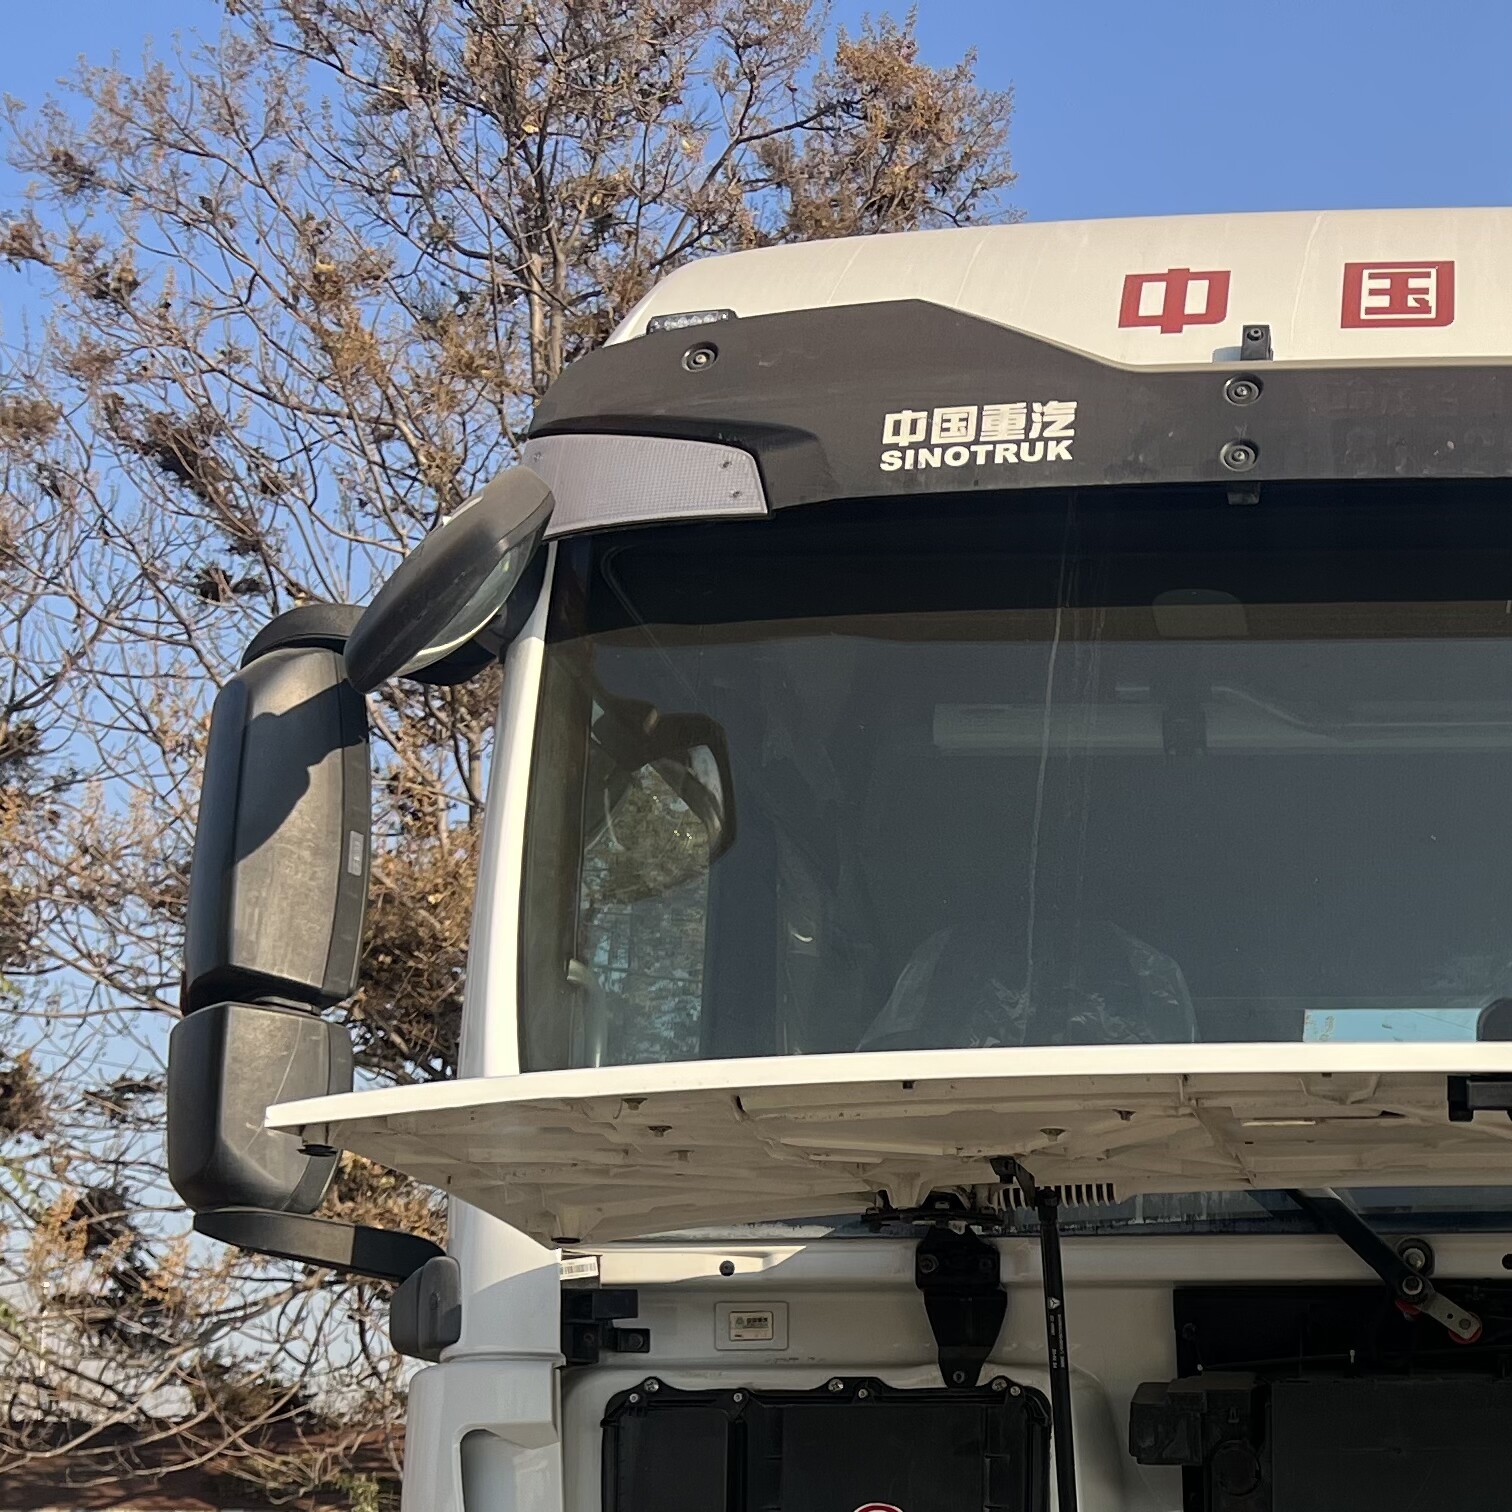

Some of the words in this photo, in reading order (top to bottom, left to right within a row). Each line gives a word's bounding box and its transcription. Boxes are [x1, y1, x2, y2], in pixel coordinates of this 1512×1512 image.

[882, 401, 1078, 447] 中国重汽
[879, 439, 1074, 472] SINOTRUK
